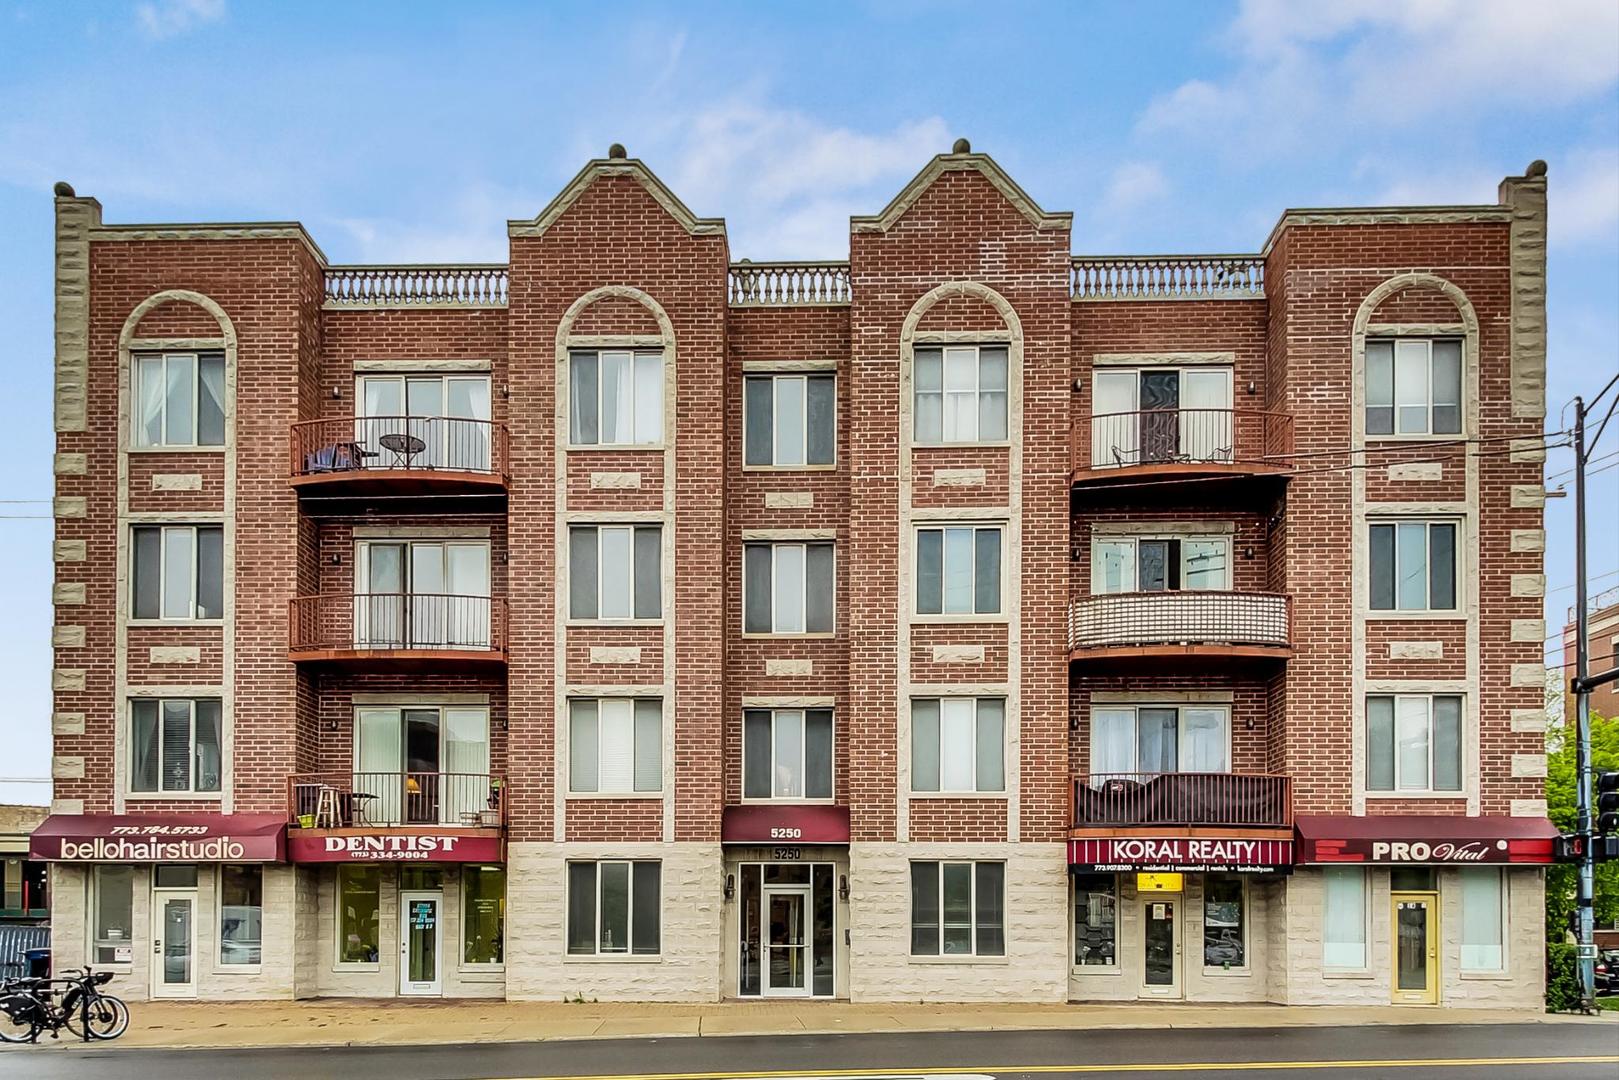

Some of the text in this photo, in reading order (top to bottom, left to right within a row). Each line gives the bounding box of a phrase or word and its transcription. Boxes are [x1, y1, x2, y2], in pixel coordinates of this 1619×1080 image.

[770, 828, 802, 838] 5250
[60, 836, 245, 859] bellohairstudio
[325, 836, 459, 851] DENTIST
[1113, 840, 1256, 859] KORAL REALTY
[370, 851, 429, 859] 334-9004
[774, 848, 801, 859] 5250
[1372, 842, 1490, 861] PRO Vital
[1175, 864, 1206, 872] commercial
